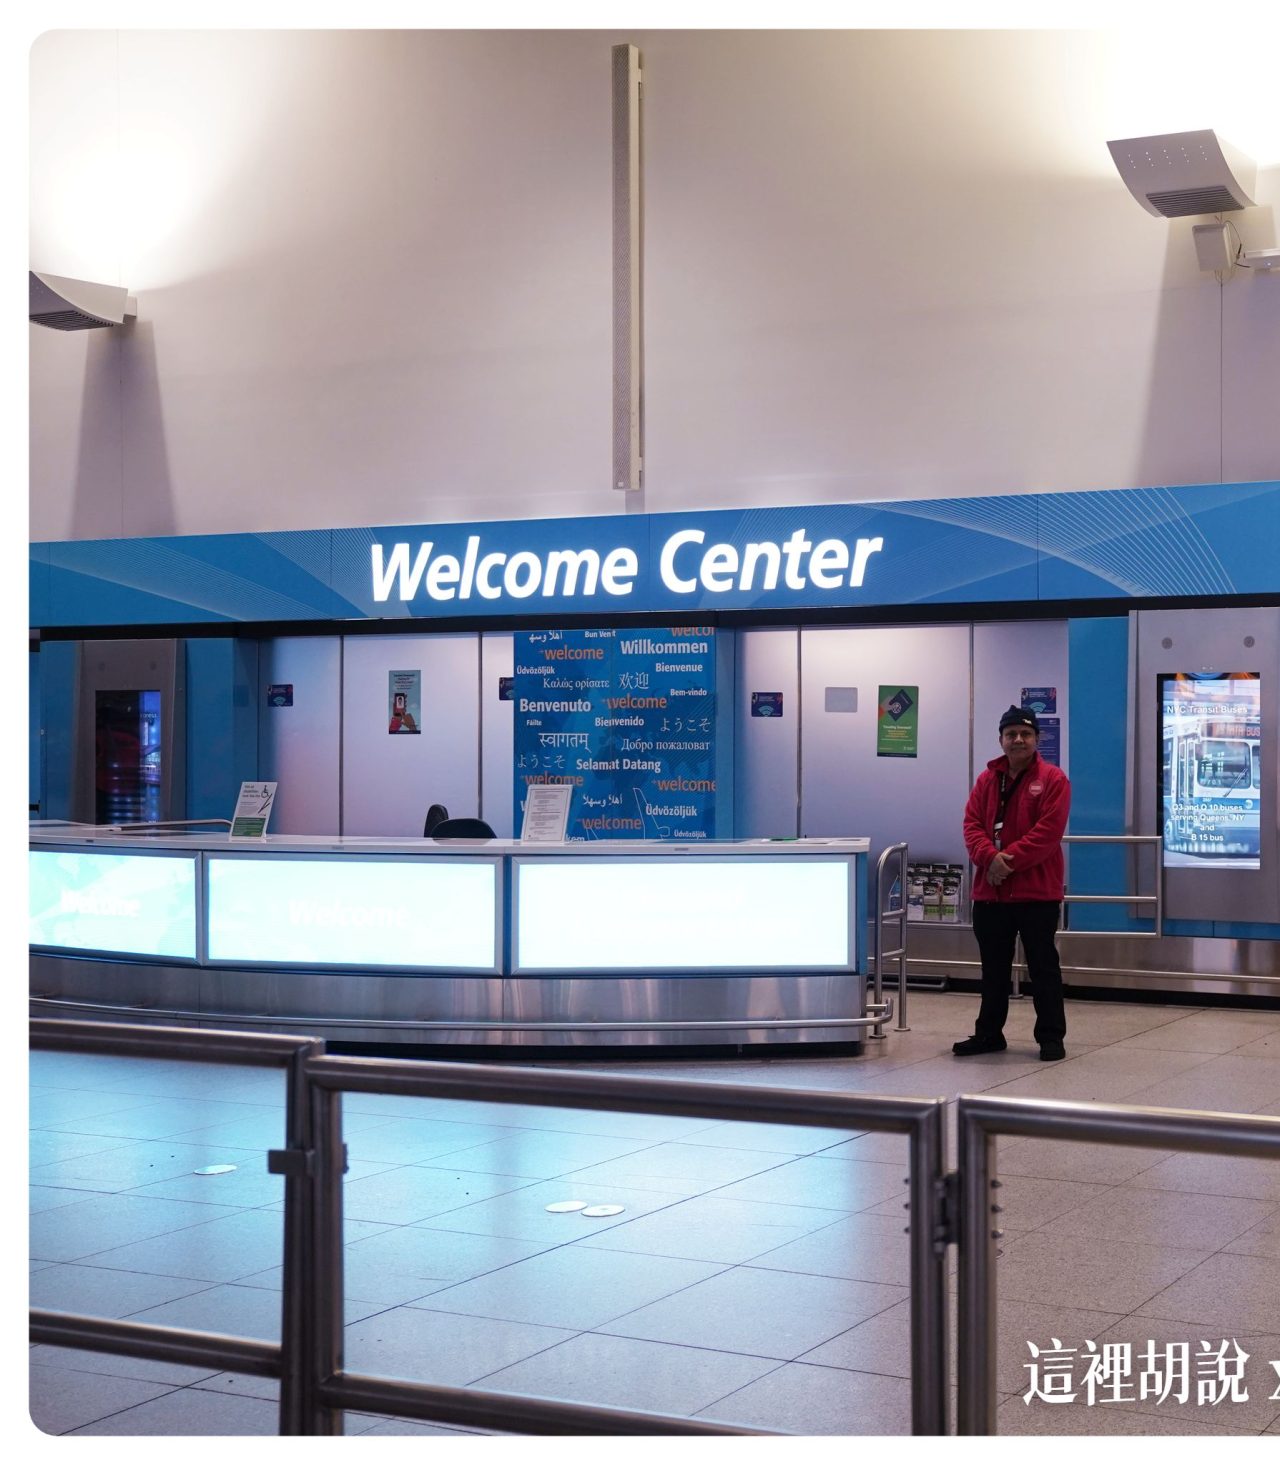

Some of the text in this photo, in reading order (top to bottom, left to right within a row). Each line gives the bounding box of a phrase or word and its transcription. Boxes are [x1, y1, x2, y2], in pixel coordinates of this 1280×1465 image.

[371, 528, 884, 602] Welcome Center
[671, 627, 715, 637] welco
[544, 644, 604, 660] welcome
[620, 638, 708, 654] Willkommen
[655, 662, 703, 672] Bienvenue
[618, 672, 650, 690] 欢迎
[670, 688, 708, 696] Bem-vindo
[520, 698, 592, 712] Benvenuto
[606, 693, 668, 709] welcome
[1166, 704, 1248, 714] NYC Transit Buses
[594, 716, 645, 727] Bienvenido
[660, 718, 710, 732] ようこそ
[621, 738, 654, 752] Добро
[517, 754, 566, 769] ようこそ
[576, 758, 662, 774] Selamat Datang
[524, 770, 584, 786] welcome
[582, 814, 642, 830] welcome
[1170, 814, 1198, 822] serving
